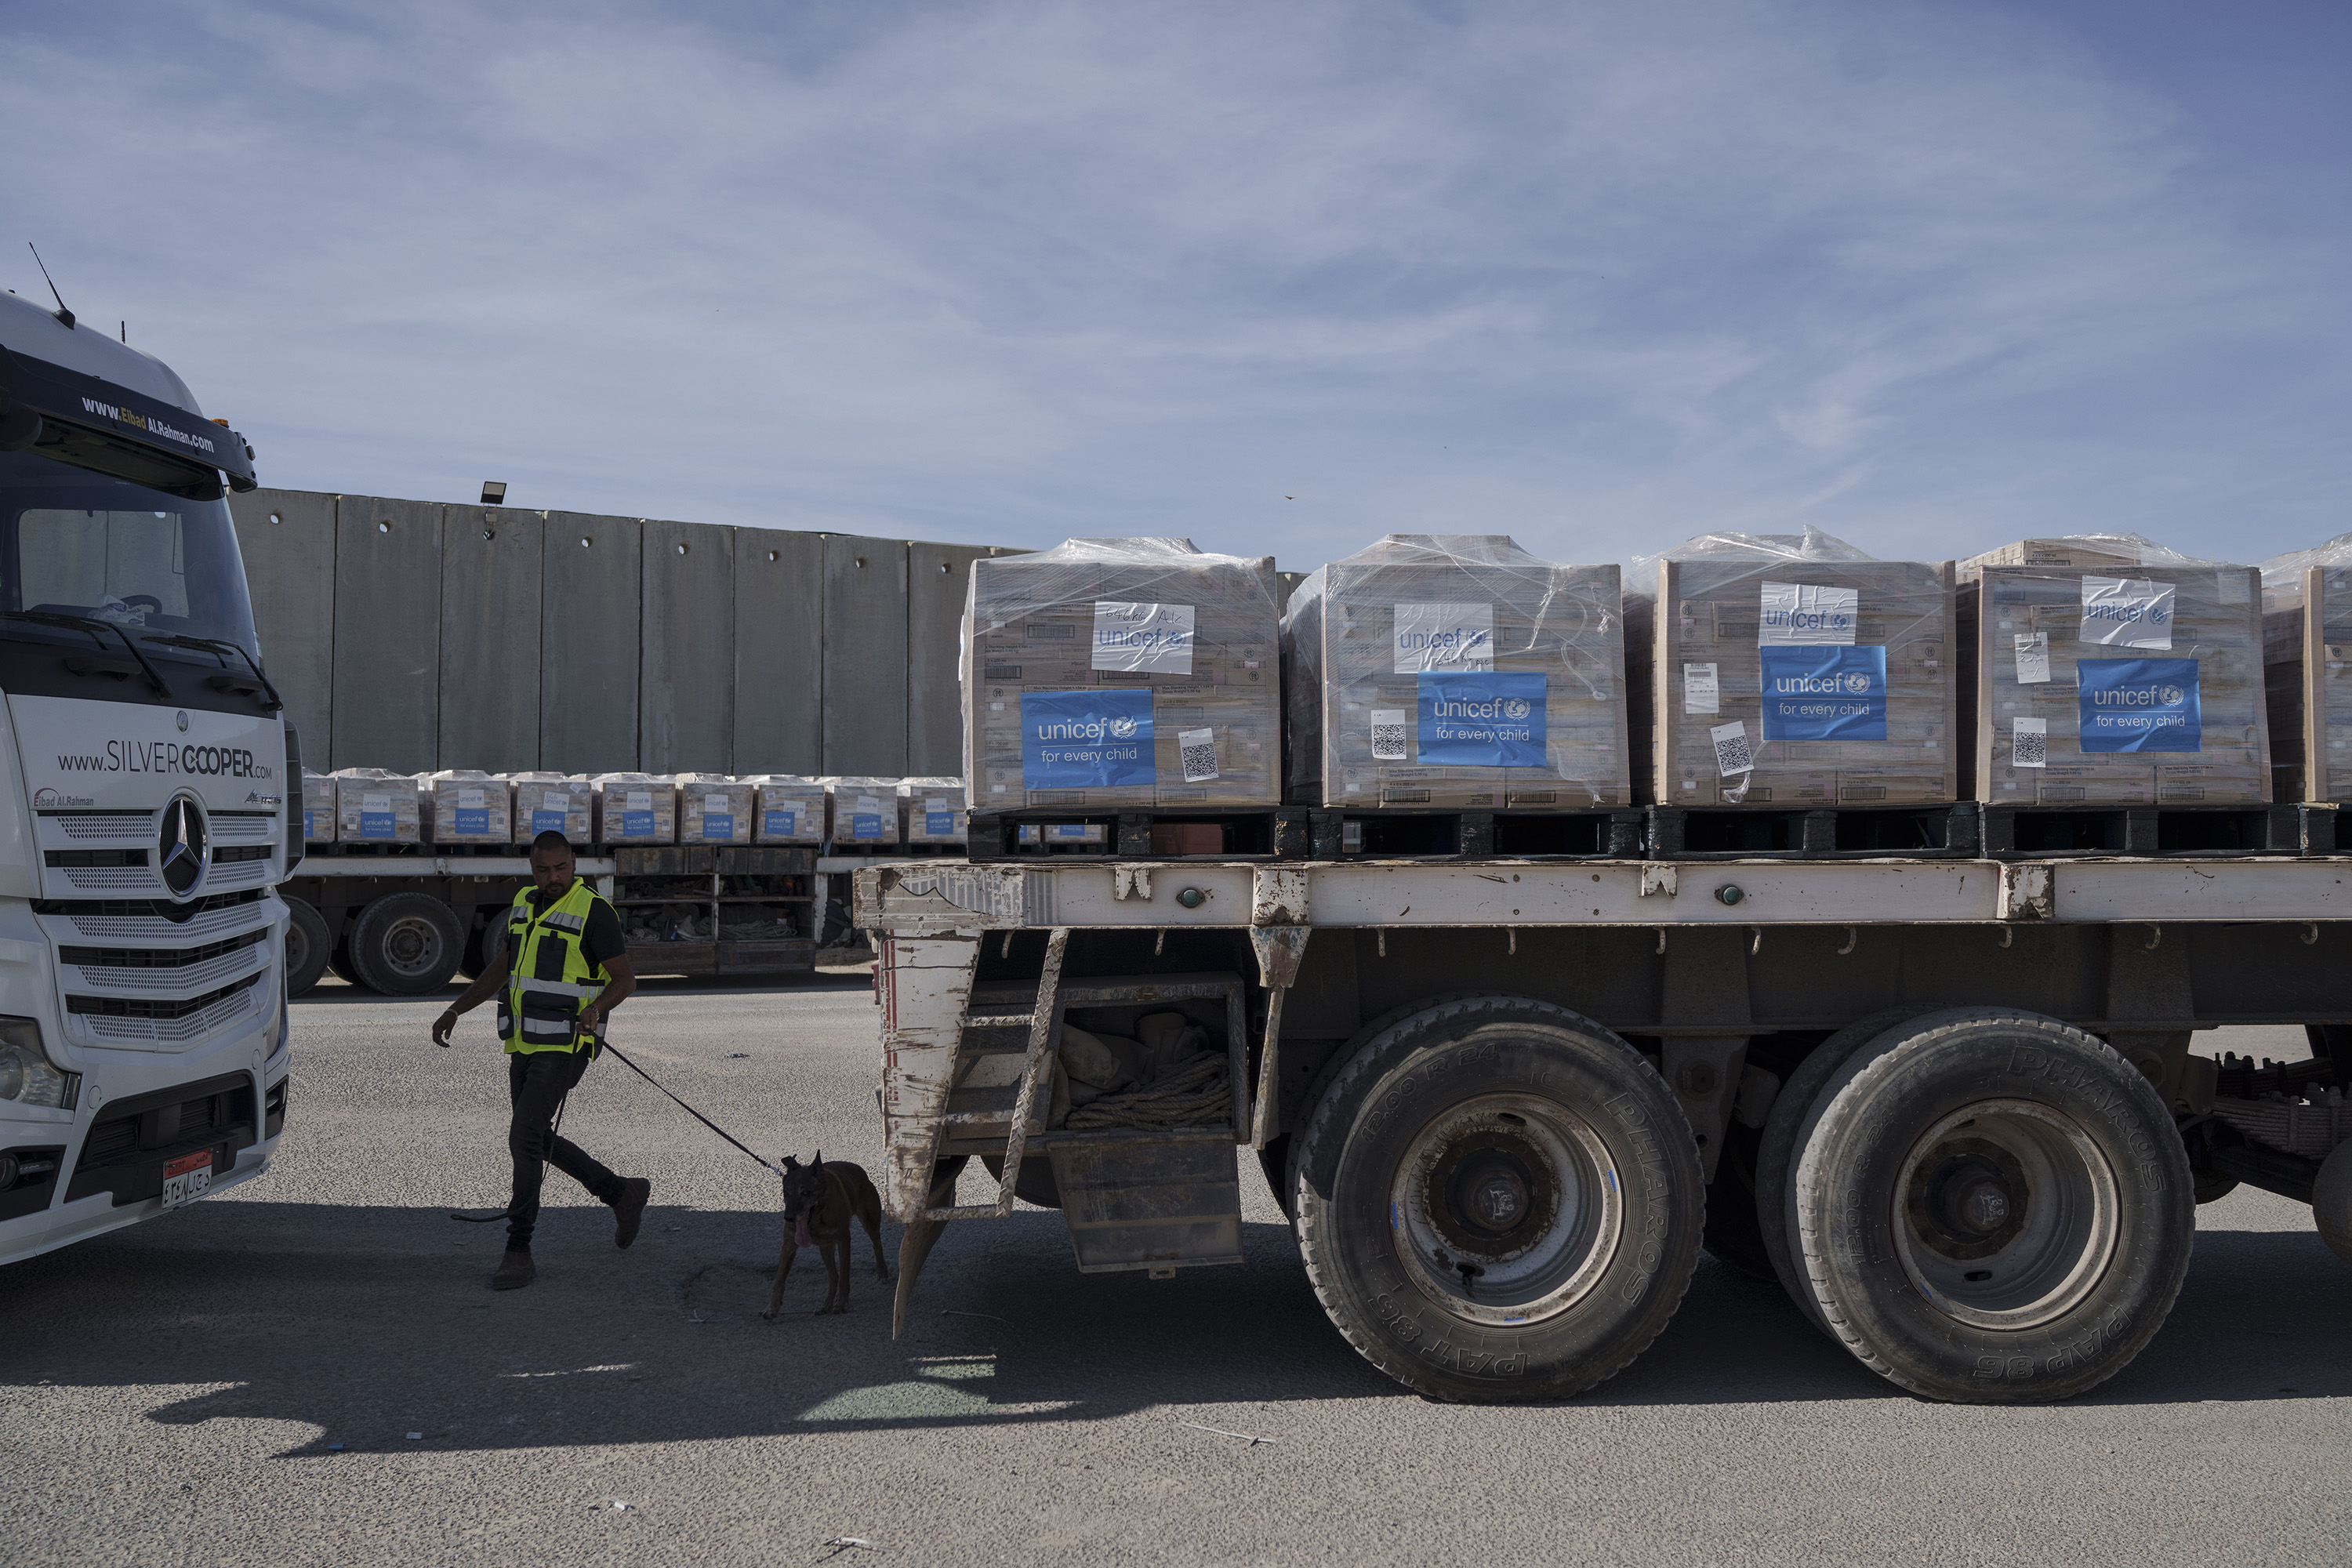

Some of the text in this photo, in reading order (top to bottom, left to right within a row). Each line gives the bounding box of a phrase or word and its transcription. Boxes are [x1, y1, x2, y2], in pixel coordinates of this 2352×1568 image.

[1766, 610, 1827, 630] unicef
[2088, 601, 2145, 623] unicef
[1099, 627, 1161, 648] unicef
[1400, 628, 1461, 648] unicef
[1777, 673, 1842, 692] unicef
[2094, 685, 2158, 705] unicef
[1434, 697, 1502, 717] unicef
[1780, 702, 1869, 717] for every child
[1038, 717, 1107, 740] unicef
[2096, 716, 2184, 729] for every child
[1436, 727, 1529, 742] for every child
[1041, 747, 1137, 763] for every child
[34, 795, 94, 807] Eibad Al.Rahman
[1361, 1077, 1417, 1142] 12.00
[1425, 1058, 1449, 1080] R
[1459, 1044, 1499, 1065] 24
[2006, 1045, 2167, 1194] PHAROS
[165, 1179, 186, 1203] ٤٣٤٨
[1846, 1108, 1894, 1266] 12.00 R 24
[1604, 1091, 1668, 1308] PHAROS
[1973, 1307, 2132, 1379] PAP 86
[1421, 1339, 1527, 1376] PAT
